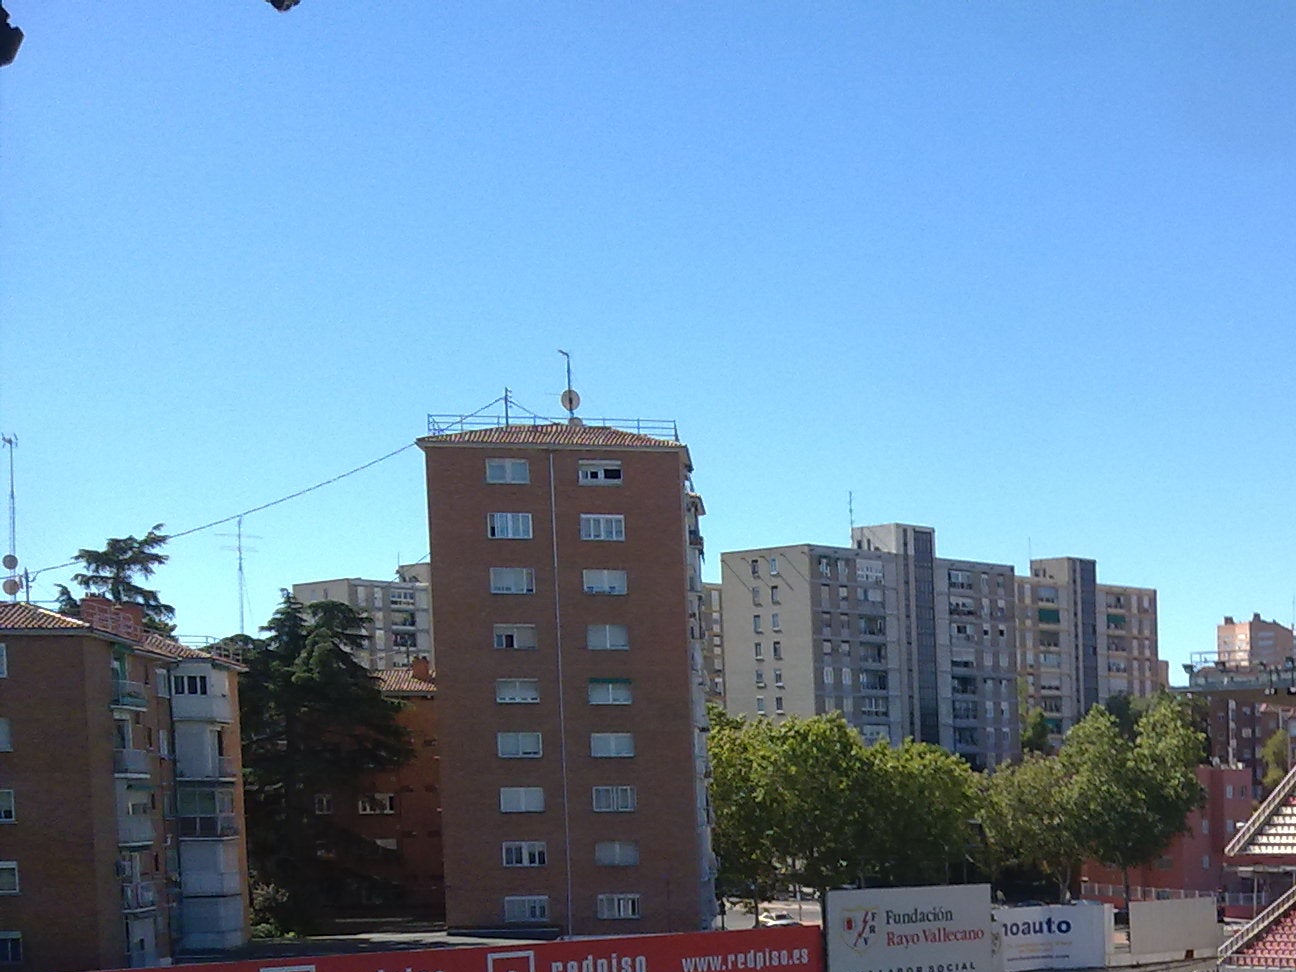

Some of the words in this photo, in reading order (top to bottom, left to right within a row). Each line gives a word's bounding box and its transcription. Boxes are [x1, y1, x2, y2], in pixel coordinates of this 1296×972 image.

[885, 906, 953, 925] Fundación
[886, 931, 920, 949] Rayo
[922, 926, 985, 944] Vallecano
